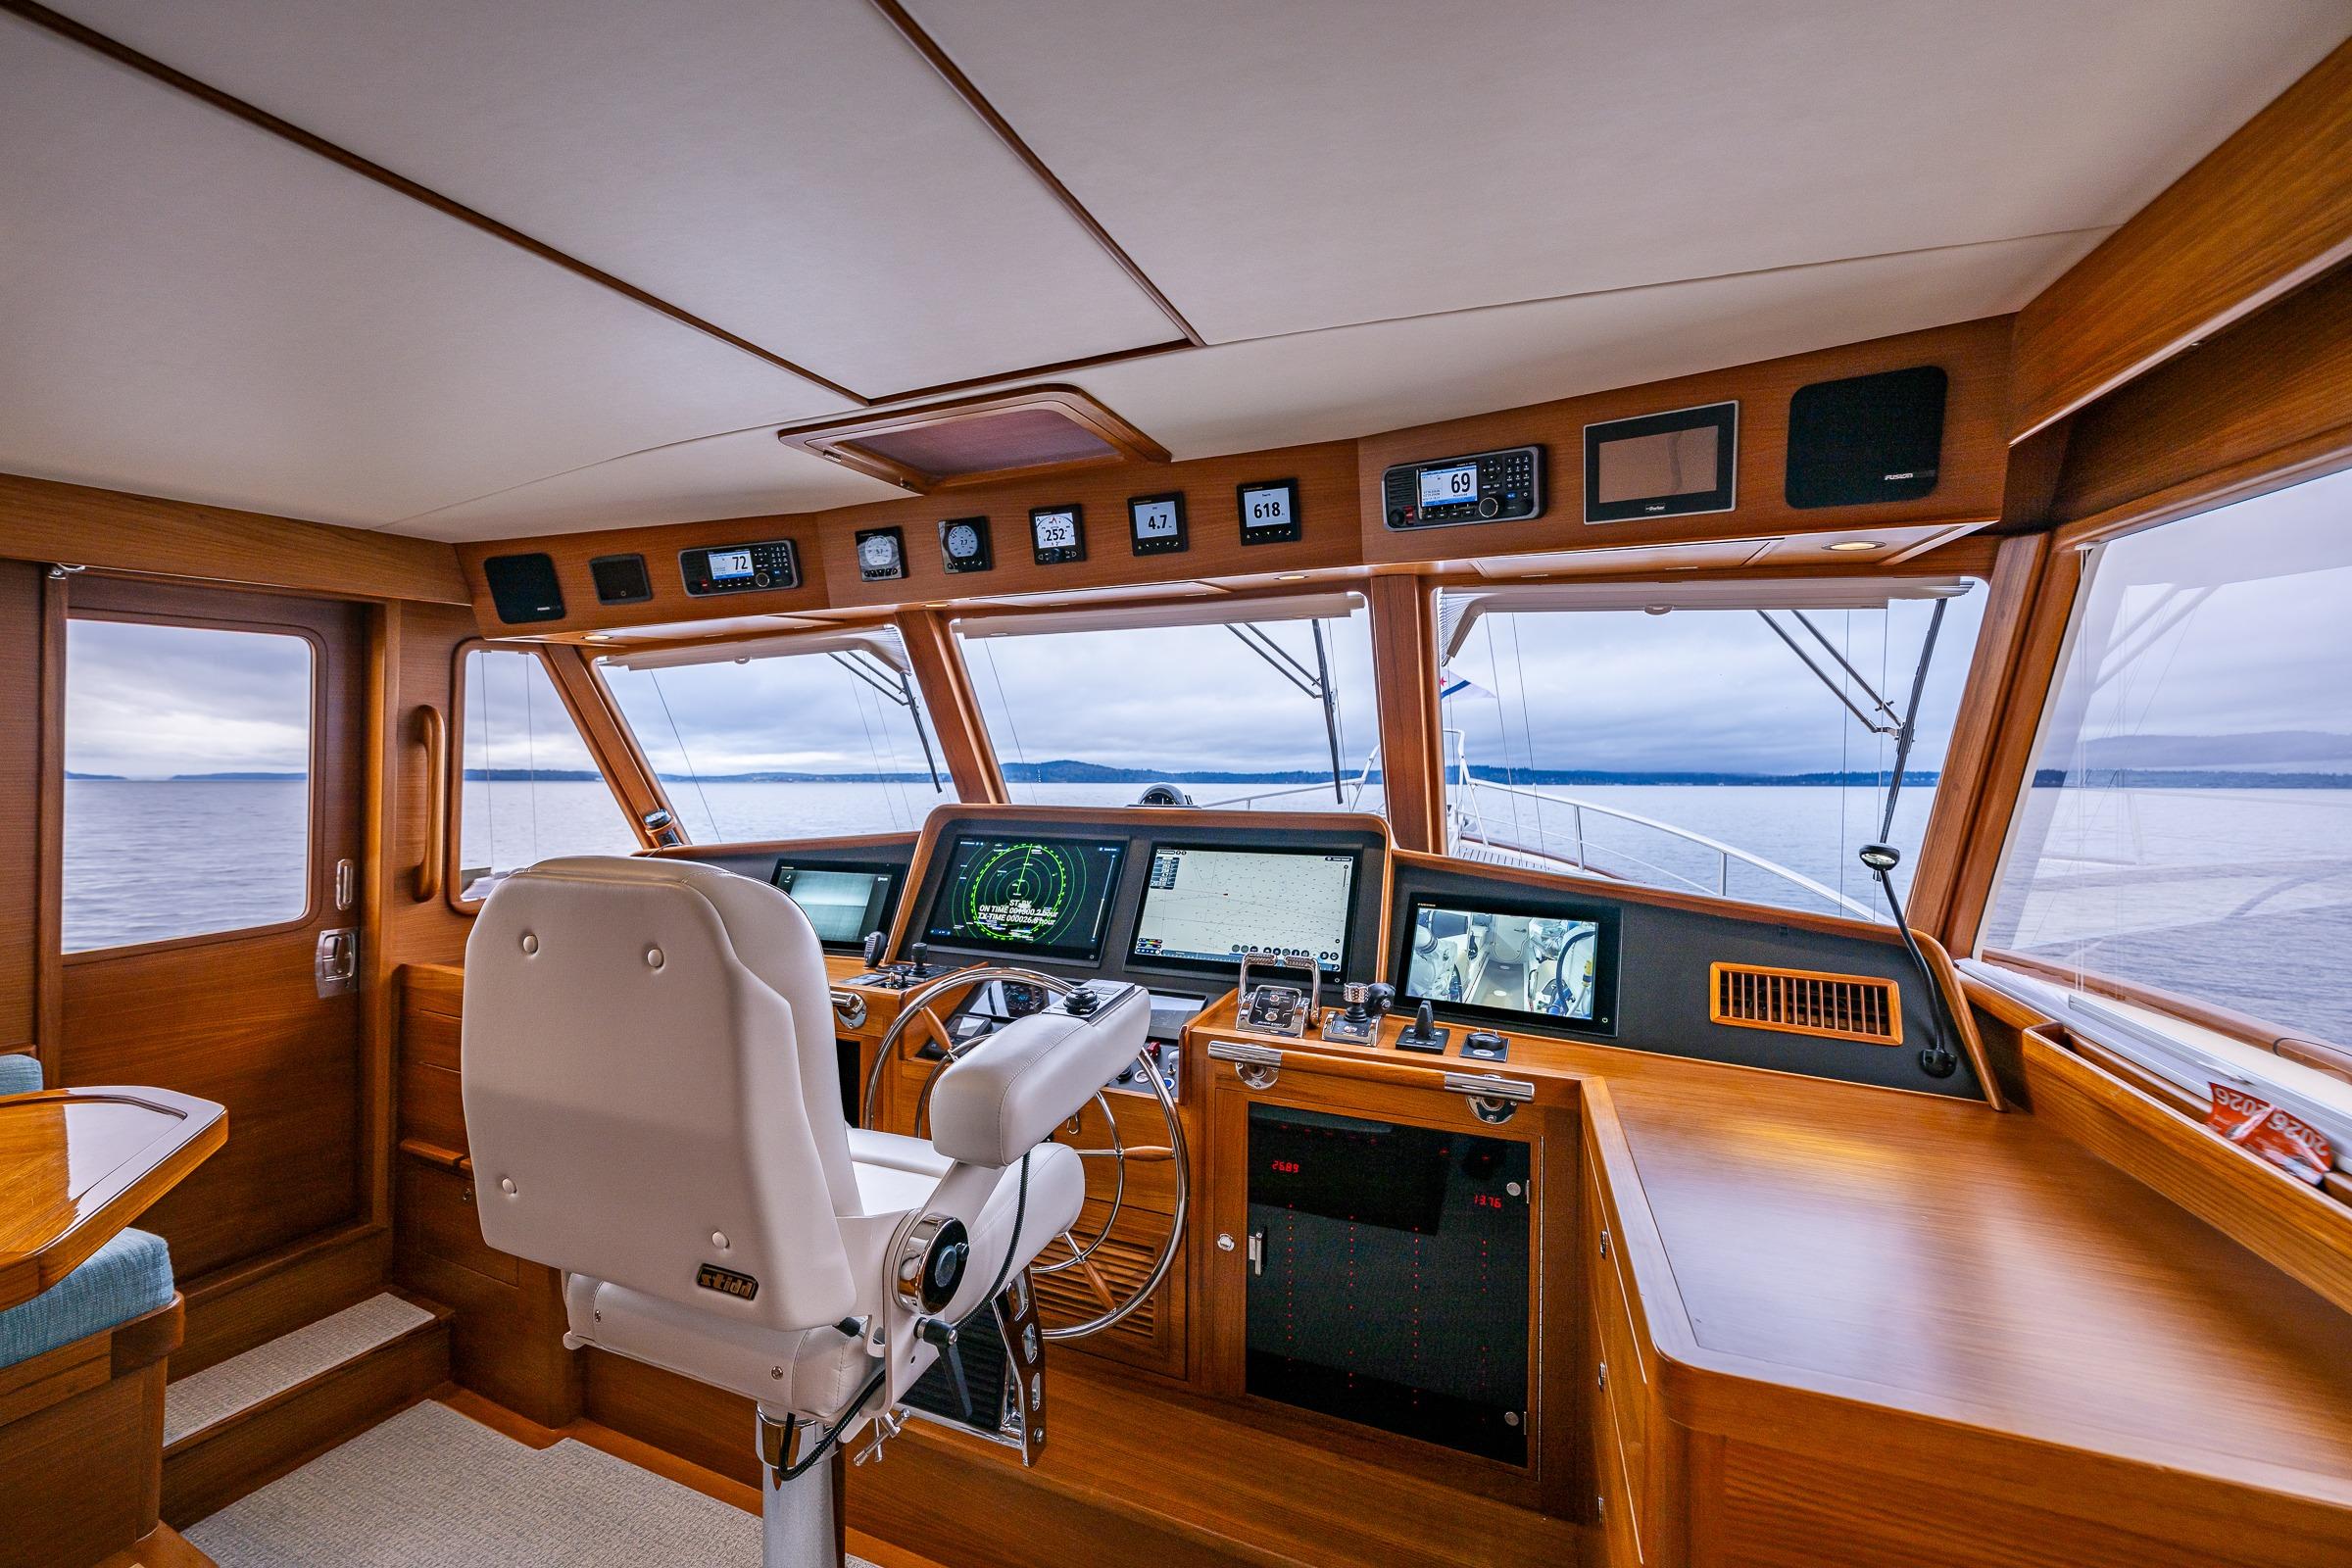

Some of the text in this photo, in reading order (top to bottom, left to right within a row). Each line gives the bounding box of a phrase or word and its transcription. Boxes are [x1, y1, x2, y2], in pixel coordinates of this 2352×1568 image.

[1450, 472, 1471, 494] 69
[1253, 502, 1281, 519] 618
[1148, 514, 1168, 530] 4.7
[732, 555, 749, 570] 72
[988, 912, 1006, 922] TIME
[991, 905, 1009, 914] TIME
